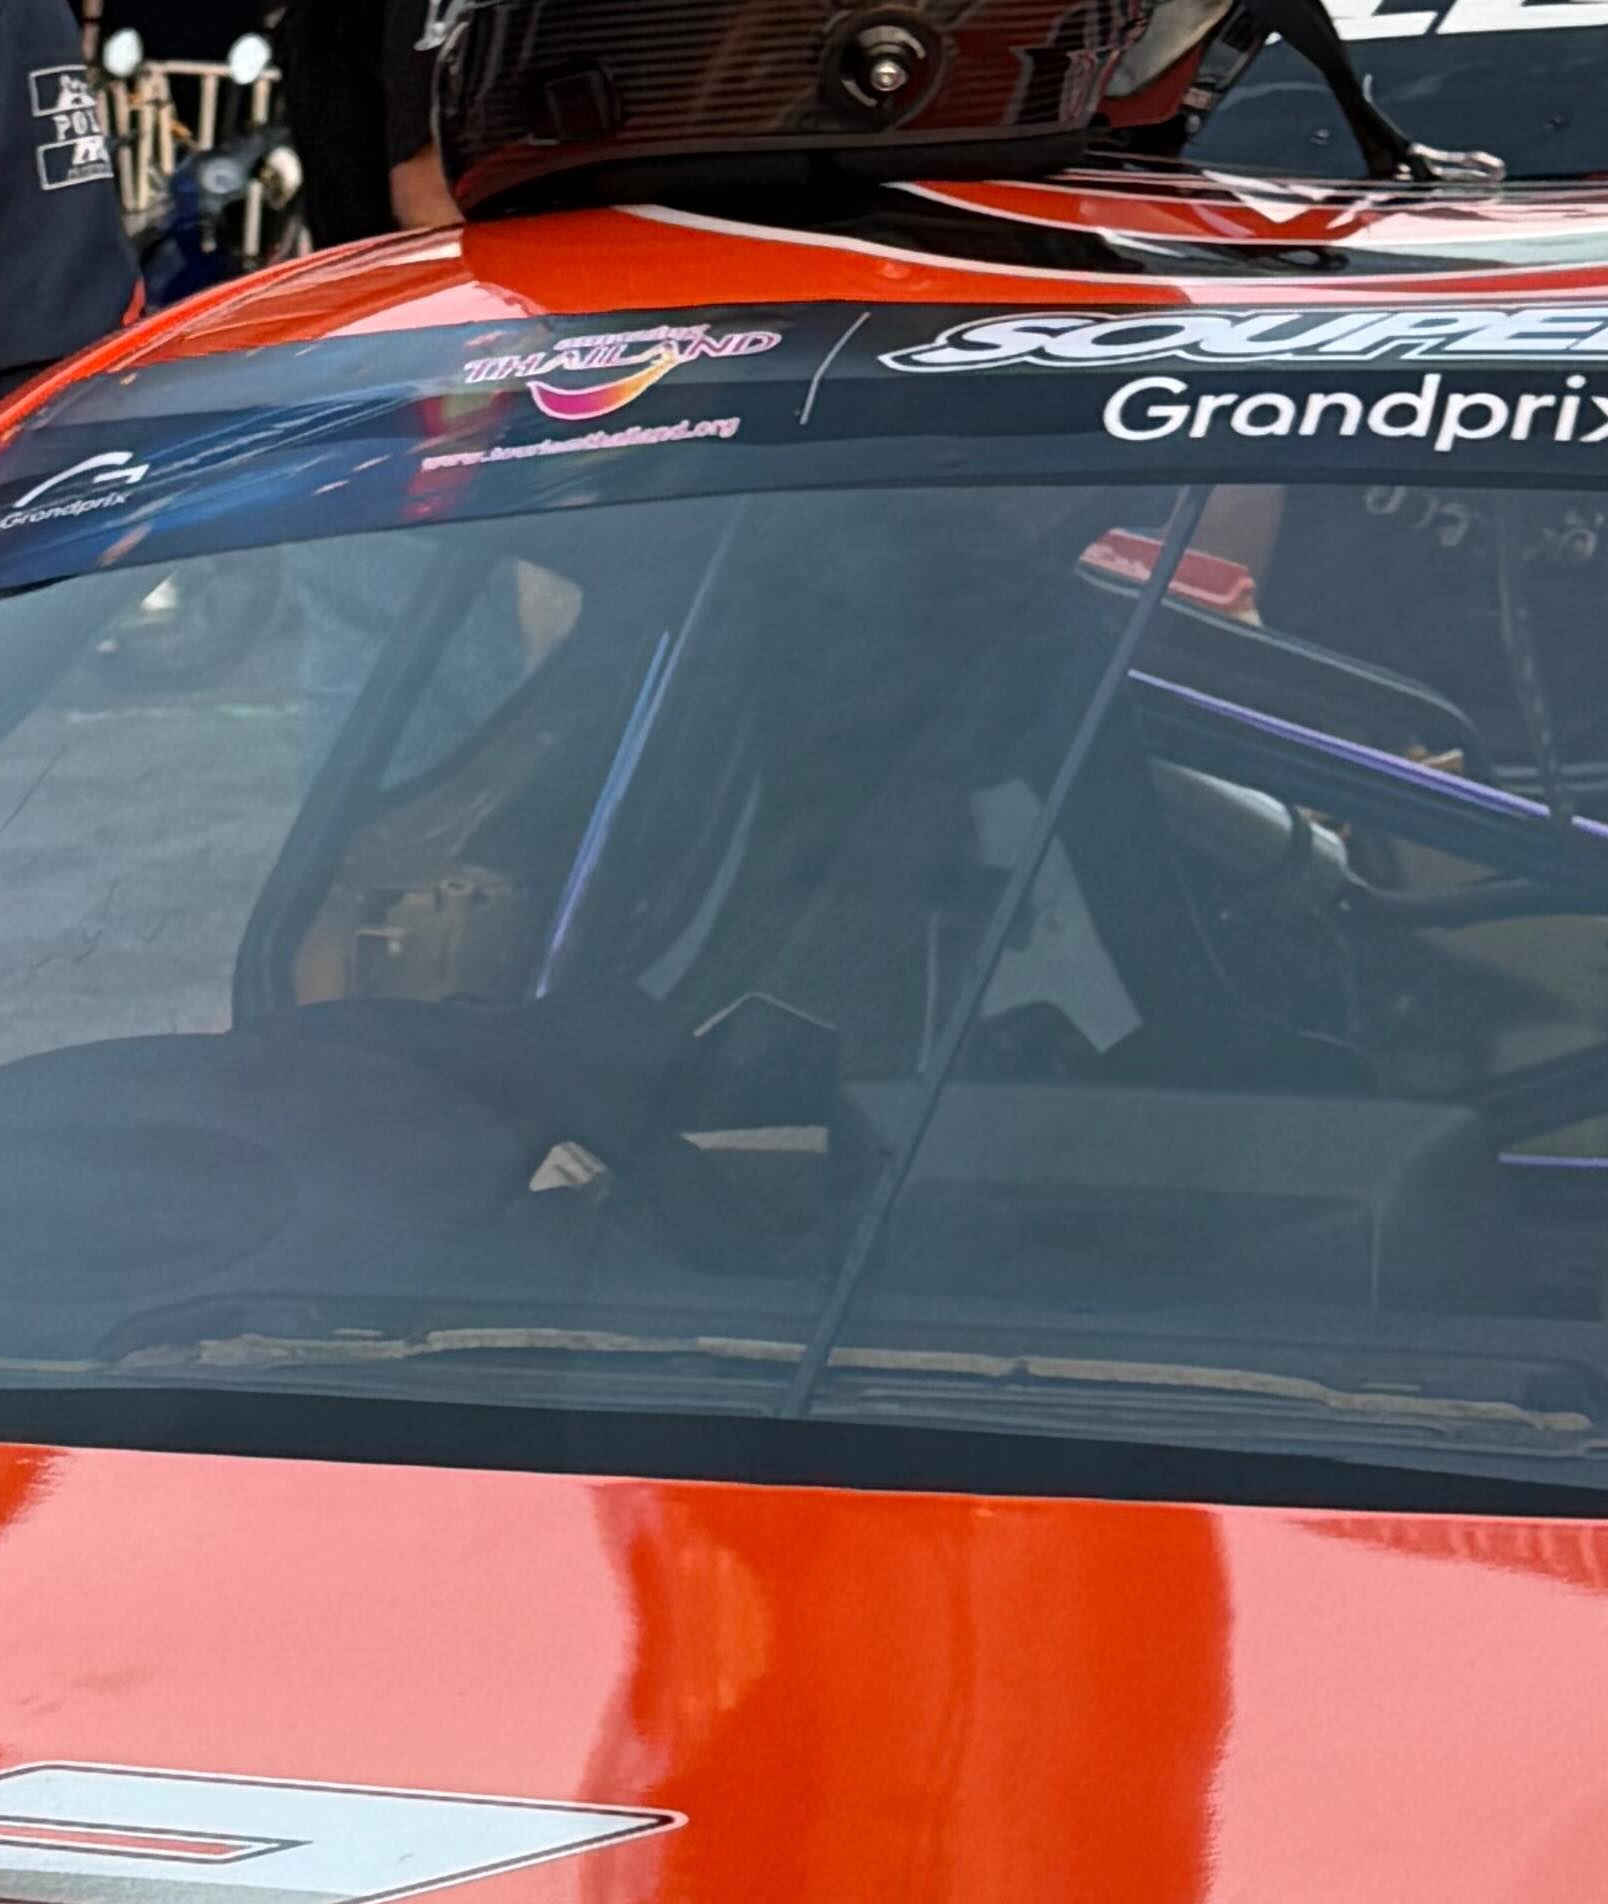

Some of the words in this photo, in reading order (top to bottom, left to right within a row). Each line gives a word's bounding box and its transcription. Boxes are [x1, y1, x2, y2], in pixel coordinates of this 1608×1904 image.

[463, 330, 784, 384] THAILAND
[880, 308, 1608, 373] SOUPE
[0, 491, 127, 530] Grandprix
